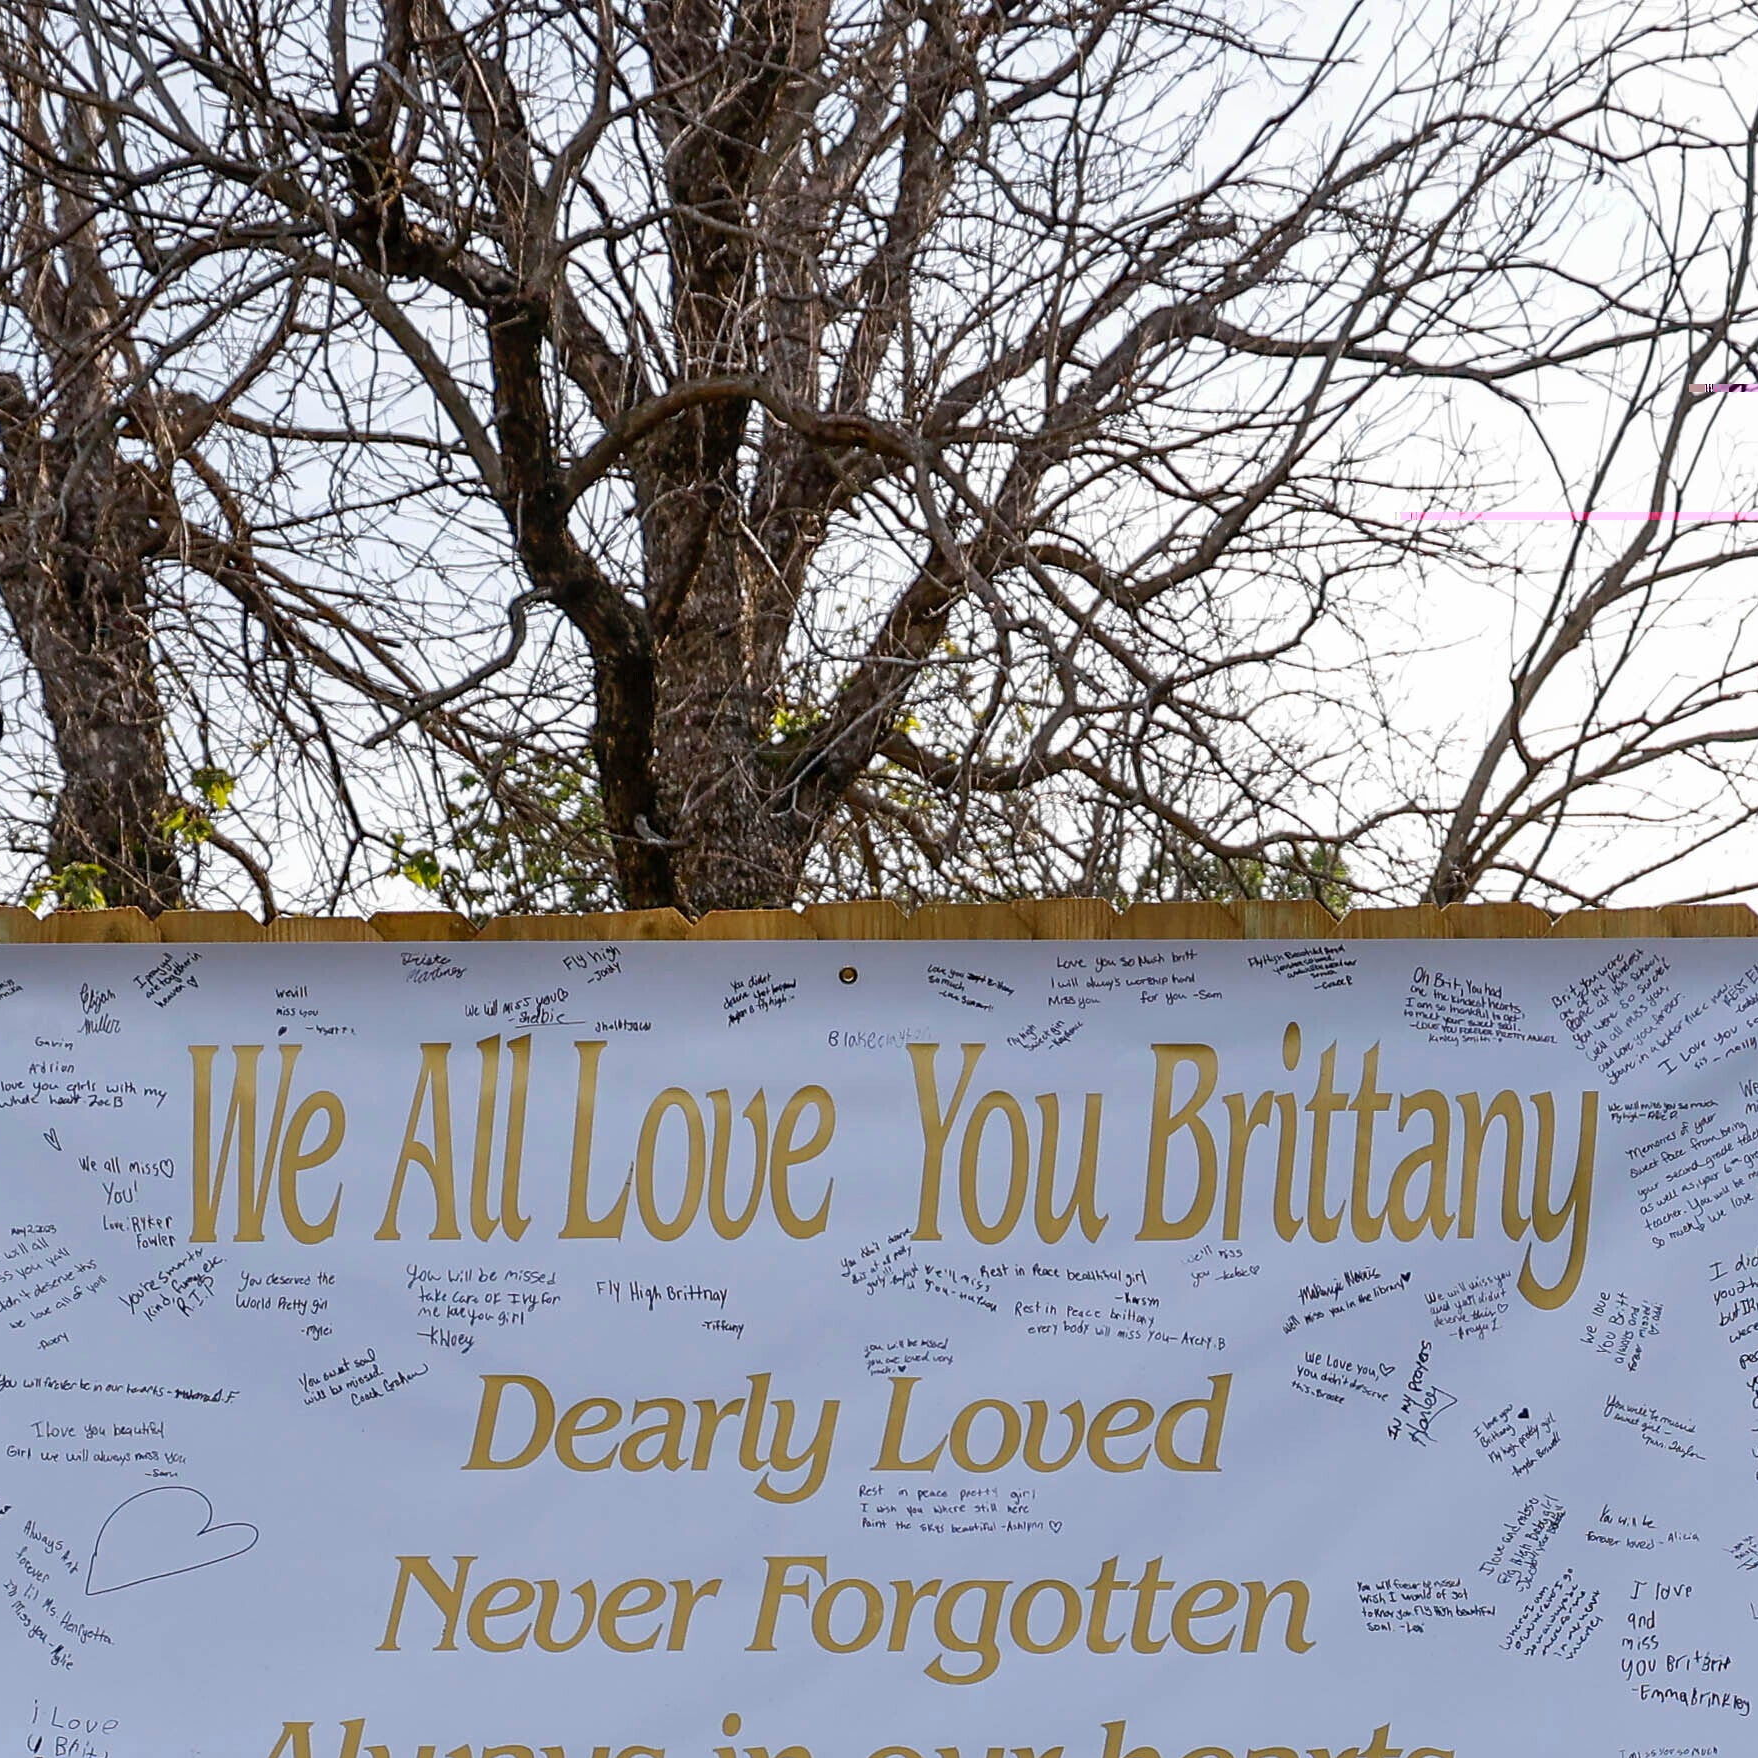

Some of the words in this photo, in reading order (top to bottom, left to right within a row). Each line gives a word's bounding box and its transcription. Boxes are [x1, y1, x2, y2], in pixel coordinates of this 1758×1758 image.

[1, 1081, 25, 1091] love
[33, 1082, 59, 1096] you
[66, 1081, 92, 1098] girls
[106, 1082, 136, 1094] with
[144, 1088, 167, 1108] my
[78, 1156, 97, 1171] We
[104, 1157, 120, 1174] all
[129, 1162, 159, 1176] miss
[189, 1045, 346, 1244] We
[376, 1035, 531, 1241] All
[560, 1041, 835, 1241] Love
[908, 1043, 1107, 1244] You
[1137, 1023, 1598, 1310] Brittany
[102, 1180, 137, 1205] You!
[1640, 1203, 1654, 1215] as
[1657, 1189, 1679, 1206] well
[131, 1215, 172, 1232] Ryker
[4, 1243, 28, 1259] will
[32, 1237, 49, 1250] all
[137, 1233, 176, 1249] Fowler
[34, 1272, 78, 1300] deserve
[74, 1260, 97, 1272] this
[238, 1271, 262, 1292] You
[266, 1273, 311, 1285] deserved
[317, 1272, 335, 1285] the
[479, 1268, 497, 1282] be
[504, 1270, 555, 1285] missed
[980, 1264, 1009, 1279] Rest
[1015, 1268, 1025, 1276] in
[1126, 1269, 1147, 1287] girl
[236, 1294, 271, 1310] World
[311, 1299, 327, 1314] girl
[597, 1280, 620, 1303] Fly
[630, 1281, 661, 1311] High
[418, 1307, 440, 1317] me
[468, 1309, 494, 1326] you
[498, 1311, 524, 1326] girl
[1015, 1301, 1041, 1316] Rest
[1046, 1305, 1056, 1315] in
[1609, 1292, 1628, 1325] Britt
[1719, 1307, 1741, 1326] but
[31, 1421, 43, 1437] I
[84, 1424, 105, 1439] you
[113, 1422, 164, 1439] beautiful
[465, 1374, 839, 1504] Dearly
[875, 1374, 1232, 1472] Loved
[7, 1445, 31, 1460] Girl
[41, 1452, 58, 1462] we
[66, 1448, 88, 1462] will
[94, 1451, 130, 1466] always
[135, 1451, 159, 1461] miss
[165, 1452, 186, 1464] you
[859, 1485, 884, 1497] Rest
[918, 1490, 947, 1501] peace
[960, 1488, 997, 1501] pretty
[1010, 1490, 1035, 1505] girl
[860, 1503, 868, 1512] I
[907, 1506, 923, 1517] you
[933, 1505, 965, 1514] where
[974, 1503, 997, 1512] still
[1007, 1505, 1029, 1514] here
[862, 1517, 886, 1528] Paint
[896, 1521, 911, 1529] the
[951, 1522, 996, 1533] beautiful
[1630, 1580, 1643, 1599] I
[1656, 1582, 1692, 1600] love
[379, 1556, 721, 1652] Never
[748, 1556, 1313, 1684] Forgotten
[1628, 1610, 1655, 1630] and
[1622, 1635, 1659, 1650] miss
[33, 1699, 38, 1723] i
[51, 1707, 118, 1734] Love
